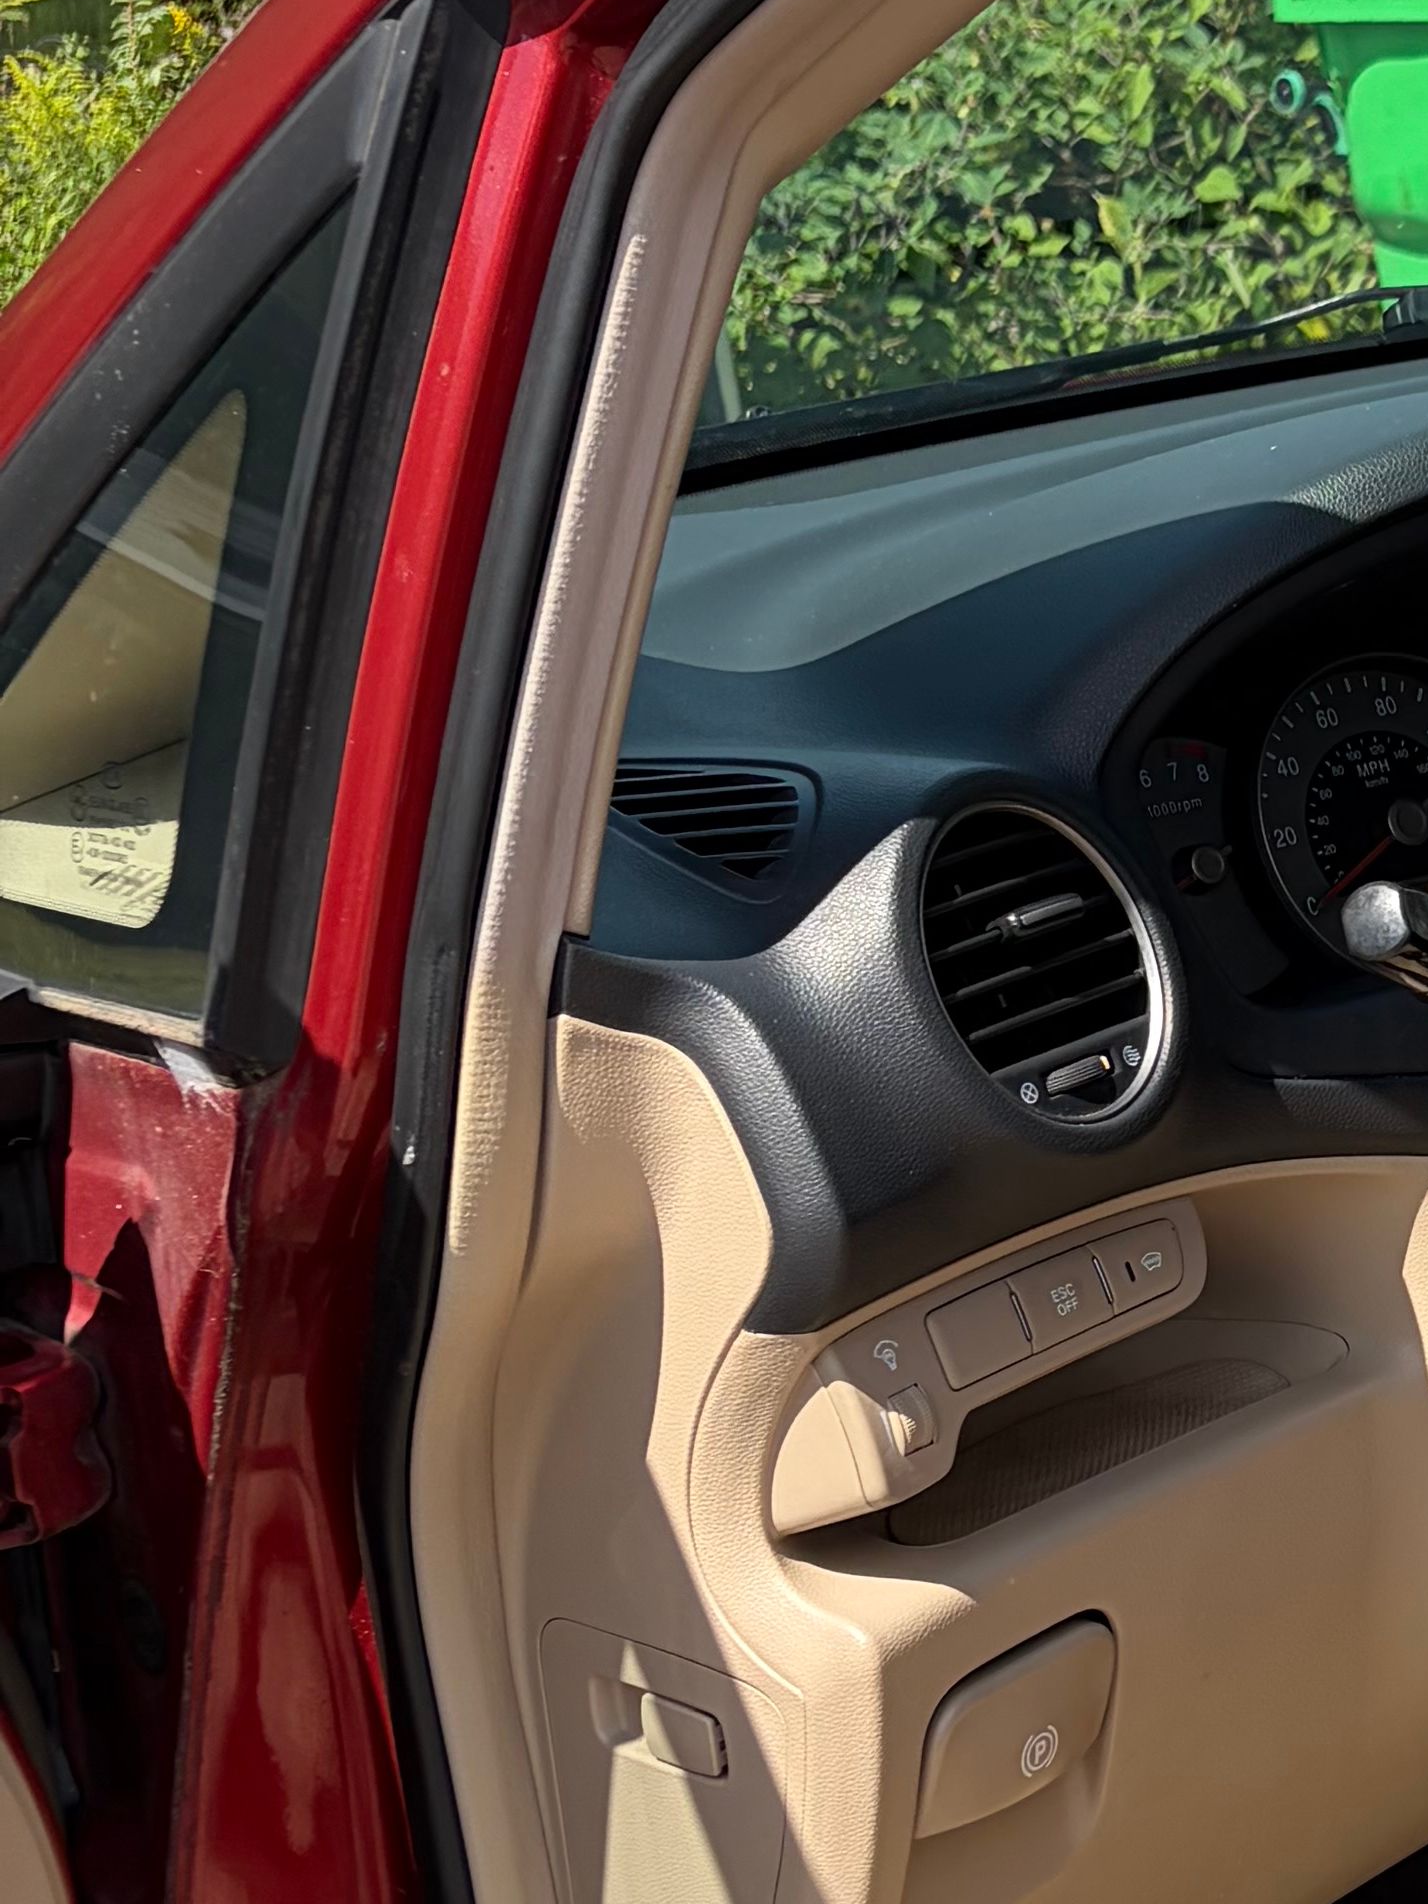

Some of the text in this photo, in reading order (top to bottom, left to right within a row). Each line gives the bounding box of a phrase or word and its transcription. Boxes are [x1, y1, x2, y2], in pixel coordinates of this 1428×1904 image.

[1374, 695, 1397, 717] 80
[1315, 707, 1339, 729] 60
[1166, 762, 1178, 781] 7
[1196, 764, 1210, 783] 8
[1277, 756, 1300, 777] 40
[1356, 758, 1391, 777] MPH
[1139, 769, 1152, 788] 6
[1273, 826, 1298, 848] 20
[1323, 843, 1337, 855] 20
[1050, 1283, 1076, 1303] ESC
[1056, 1296, 1079, 1316] OFF
